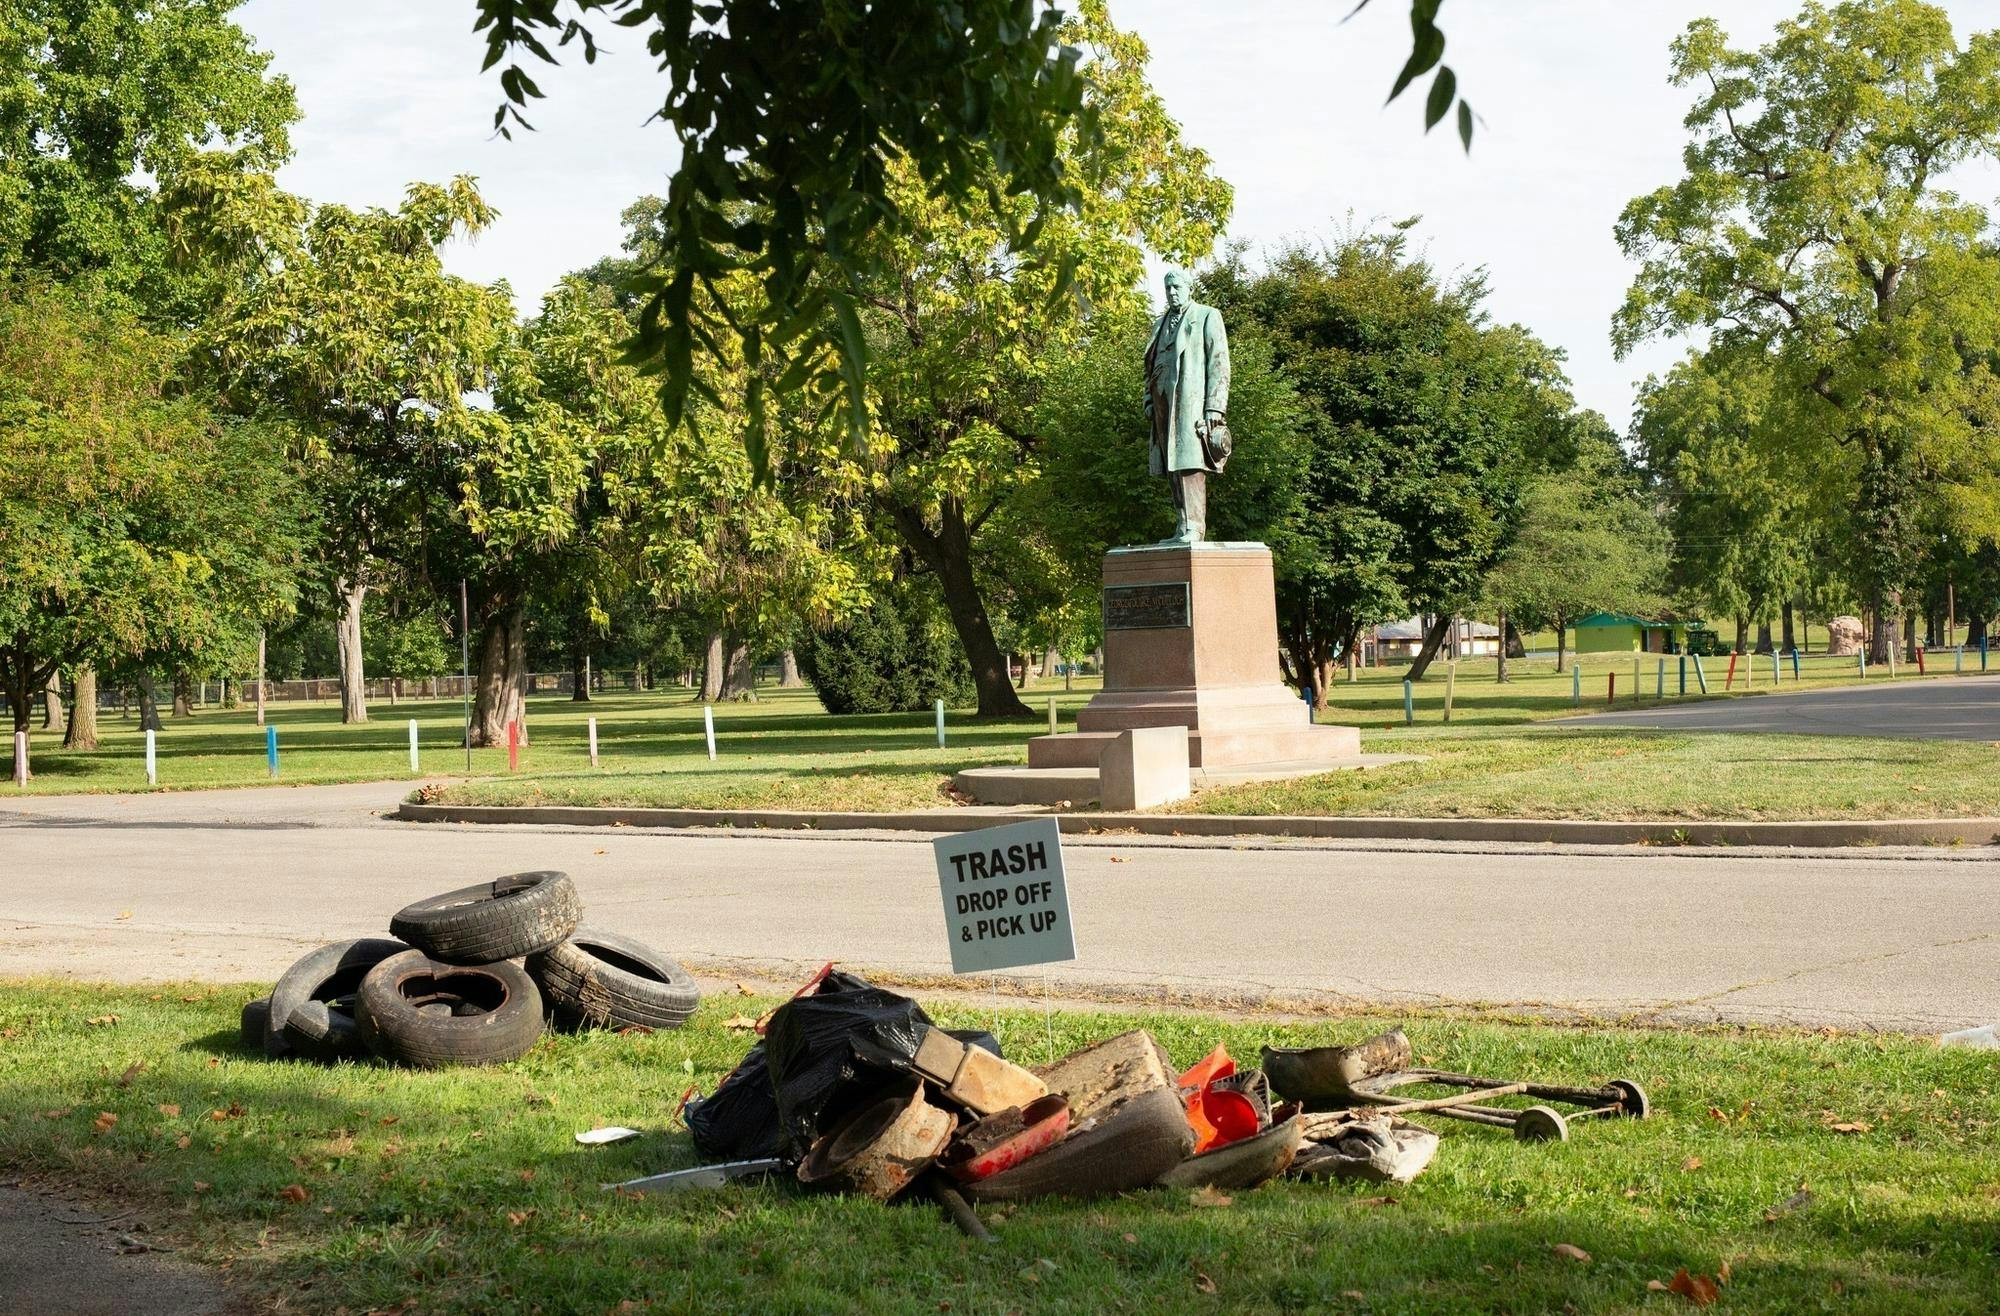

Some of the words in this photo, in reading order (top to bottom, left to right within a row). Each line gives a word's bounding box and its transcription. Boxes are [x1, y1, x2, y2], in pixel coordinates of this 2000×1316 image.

[950, 841, 1047, 883] TRASH
[956, 888, 1008, 915] DROP
[1015, 881, 1052, 906] OFF
[961, 925, 973, 943] &
[976, 915, 1025, 940] PICK
[1030, 910, 1057, 933] UP
